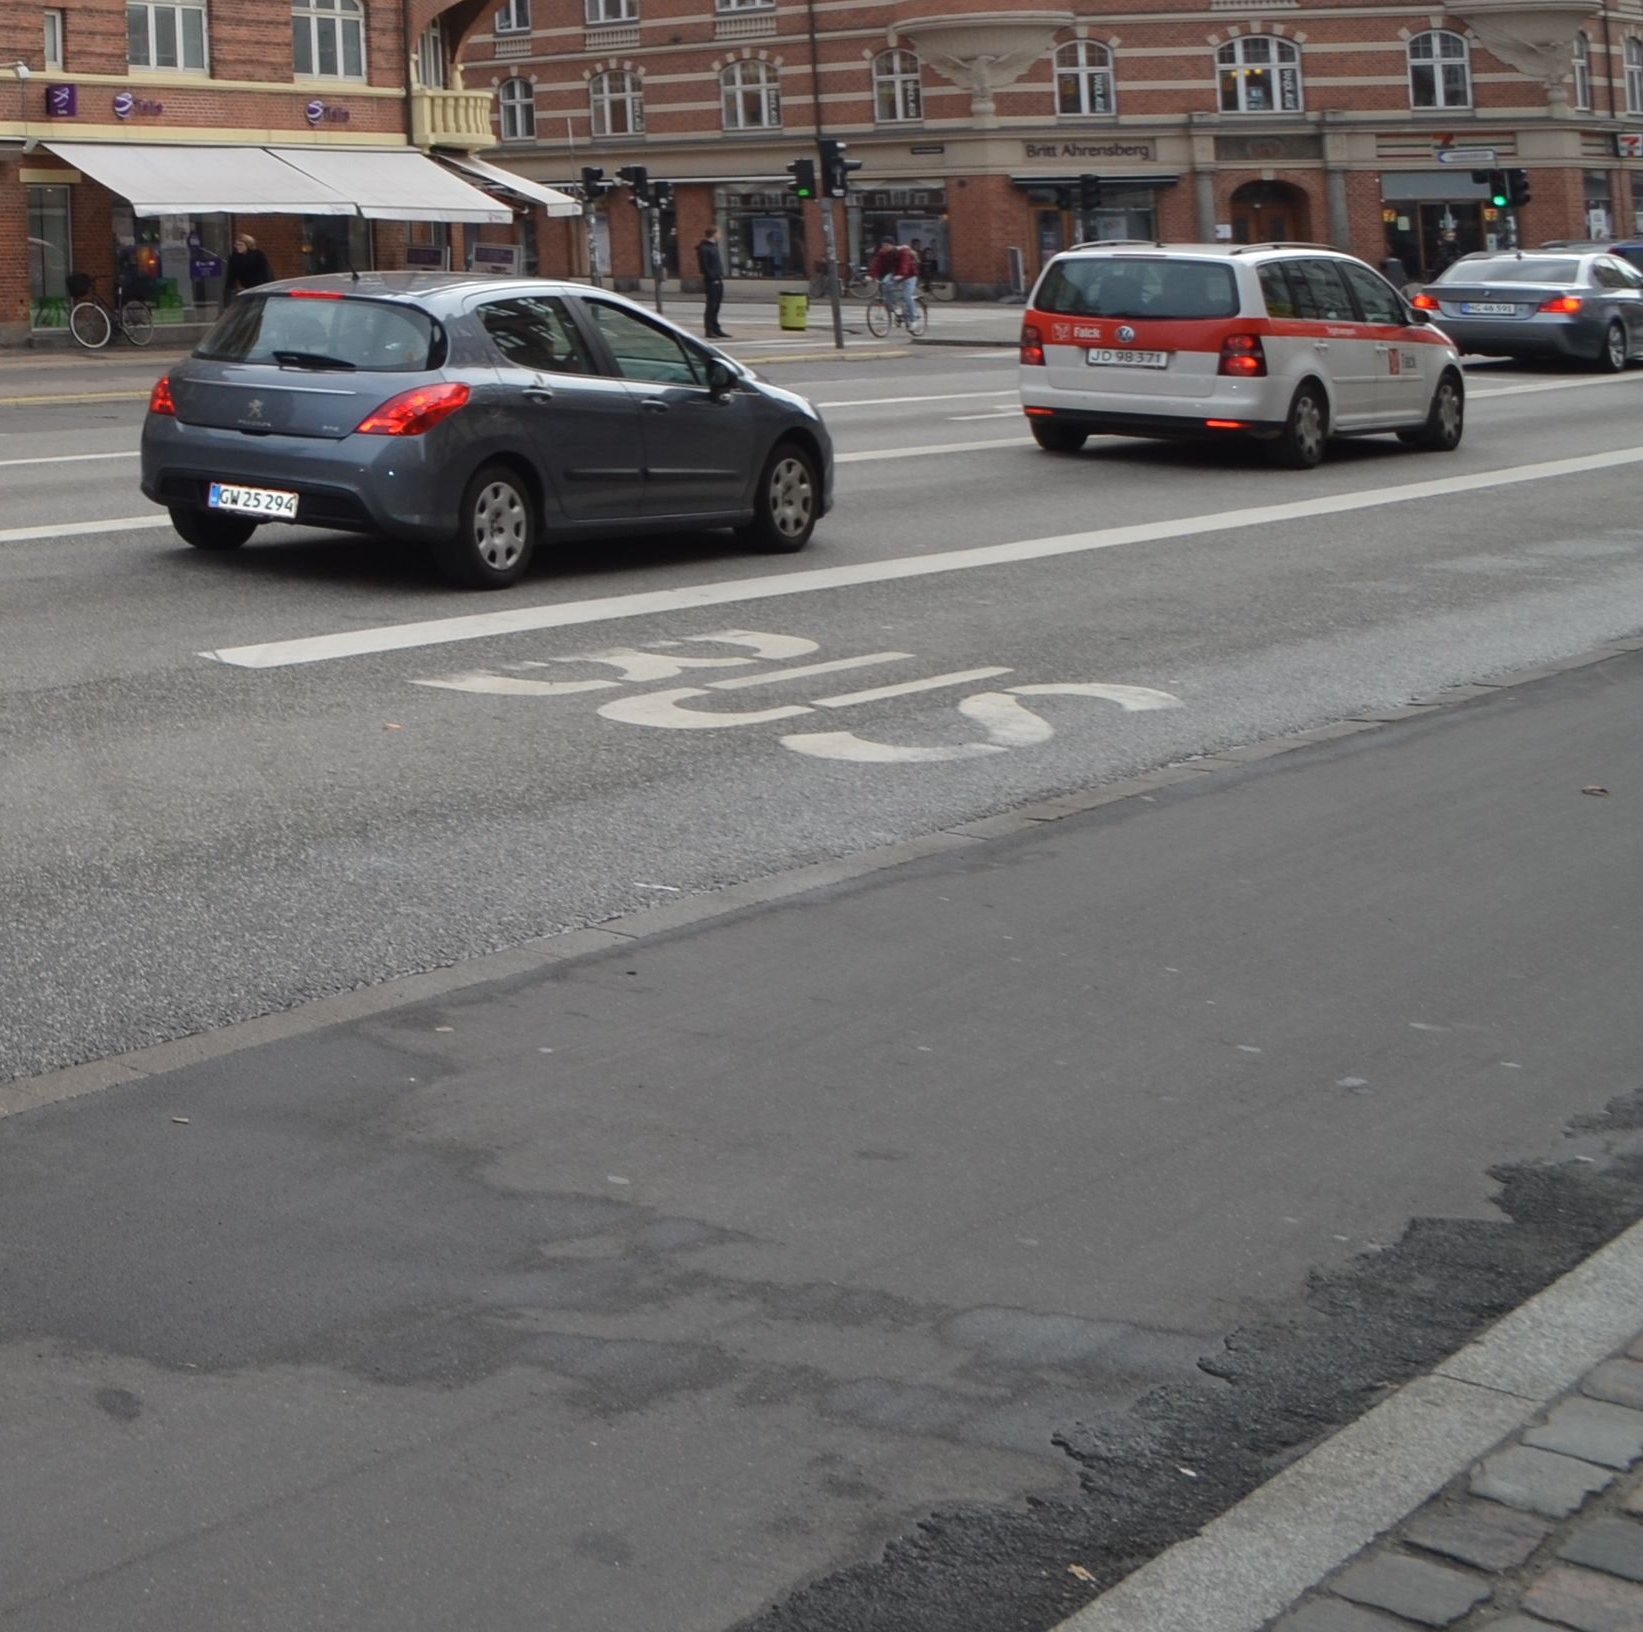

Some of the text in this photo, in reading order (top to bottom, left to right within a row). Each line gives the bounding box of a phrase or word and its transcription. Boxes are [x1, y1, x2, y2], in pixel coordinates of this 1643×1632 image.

[1026, 143, 1150, 160] Britt Ahrensberg
[1073, 326, 1101, 339] Falck
[1091, 350, 1161, 363] JD 98 371
[219, 488, 295, 513] GW 25 294
